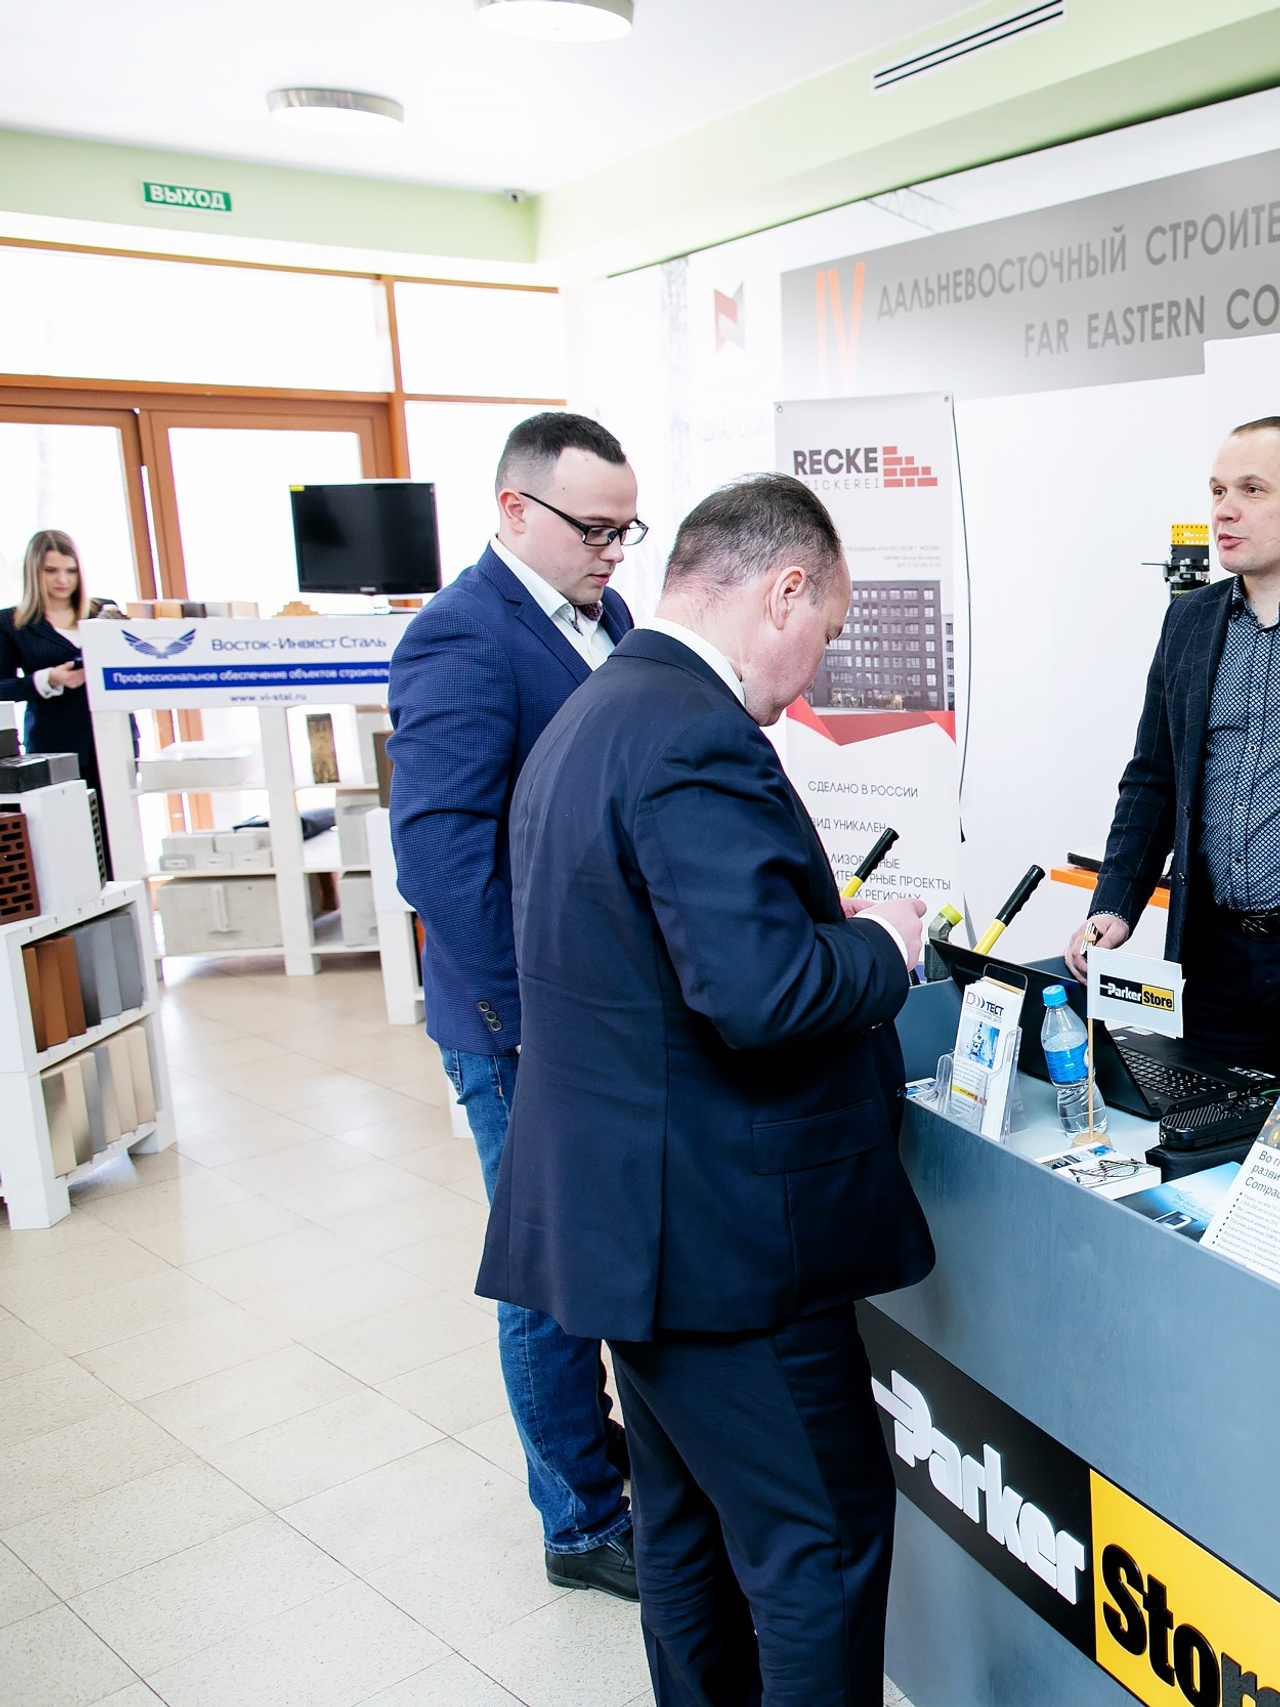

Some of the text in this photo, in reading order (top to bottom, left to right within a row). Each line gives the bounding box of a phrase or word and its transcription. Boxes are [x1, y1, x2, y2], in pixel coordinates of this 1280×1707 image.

[150, 183, 227, 212] ВЫХОД
[877, 225, 1128, 321] ДАЛЬНЕВОСТОЧНЫЙ
[1023, 321, 1070, 359] FAR
[1086, 295, 1206, 350] EASTERN
[793, 447, 878, 475] RECKE
[339, 635, 387, 650] Сталь
[808, 781, 919, 799] СДЕЛАНО В РОССИИ
[900, 875, 951, 891] ПРОЕКТЫ
[1107, 982, 1173, 1009] Parker Store
[1258, 1150, 1272, 1163] Во
[890, 1369, 1086, 1606] Parker
